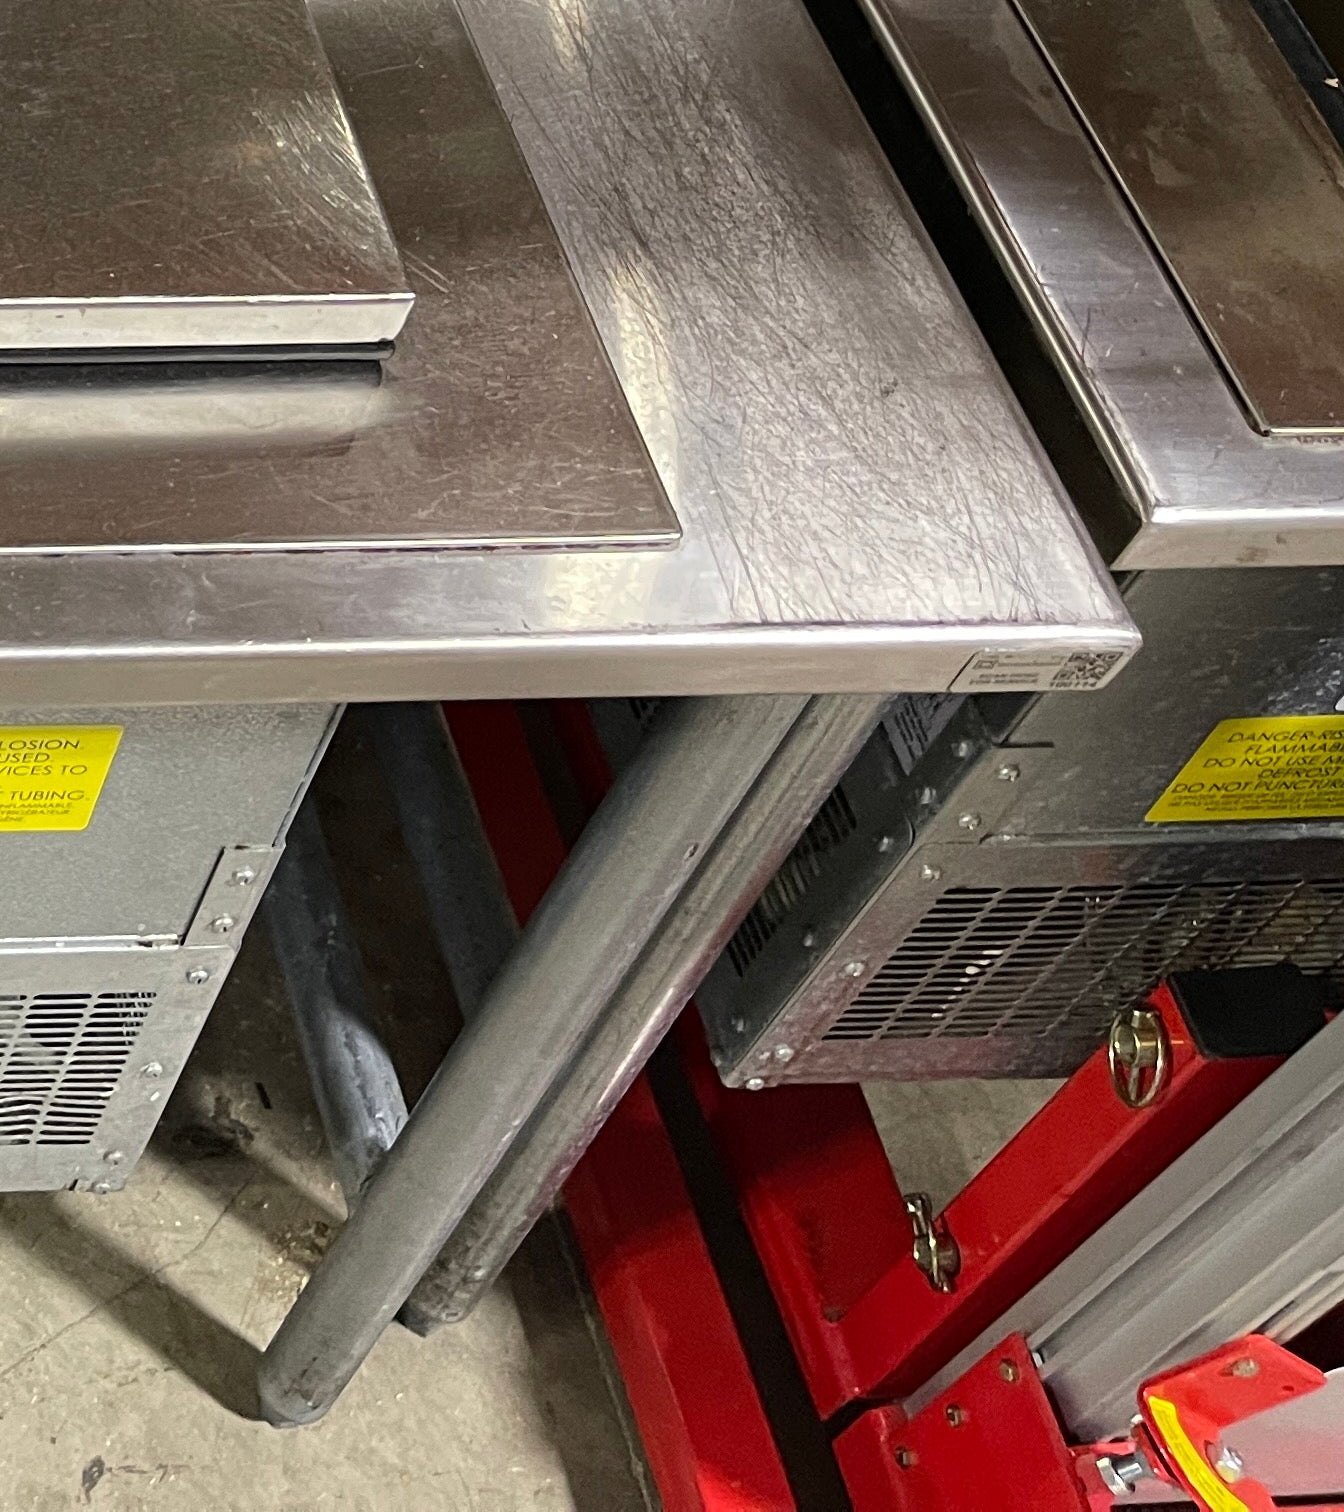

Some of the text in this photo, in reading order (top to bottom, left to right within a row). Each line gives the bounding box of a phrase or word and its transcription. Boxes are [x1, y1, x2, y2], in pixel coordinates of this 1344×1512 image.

[1203, 757, 1236, 768] DO
[61, 764, 88, 775] TO
[1171, 783, 1205, 794] DO
[10, 790, 90, 801] TUBING.
